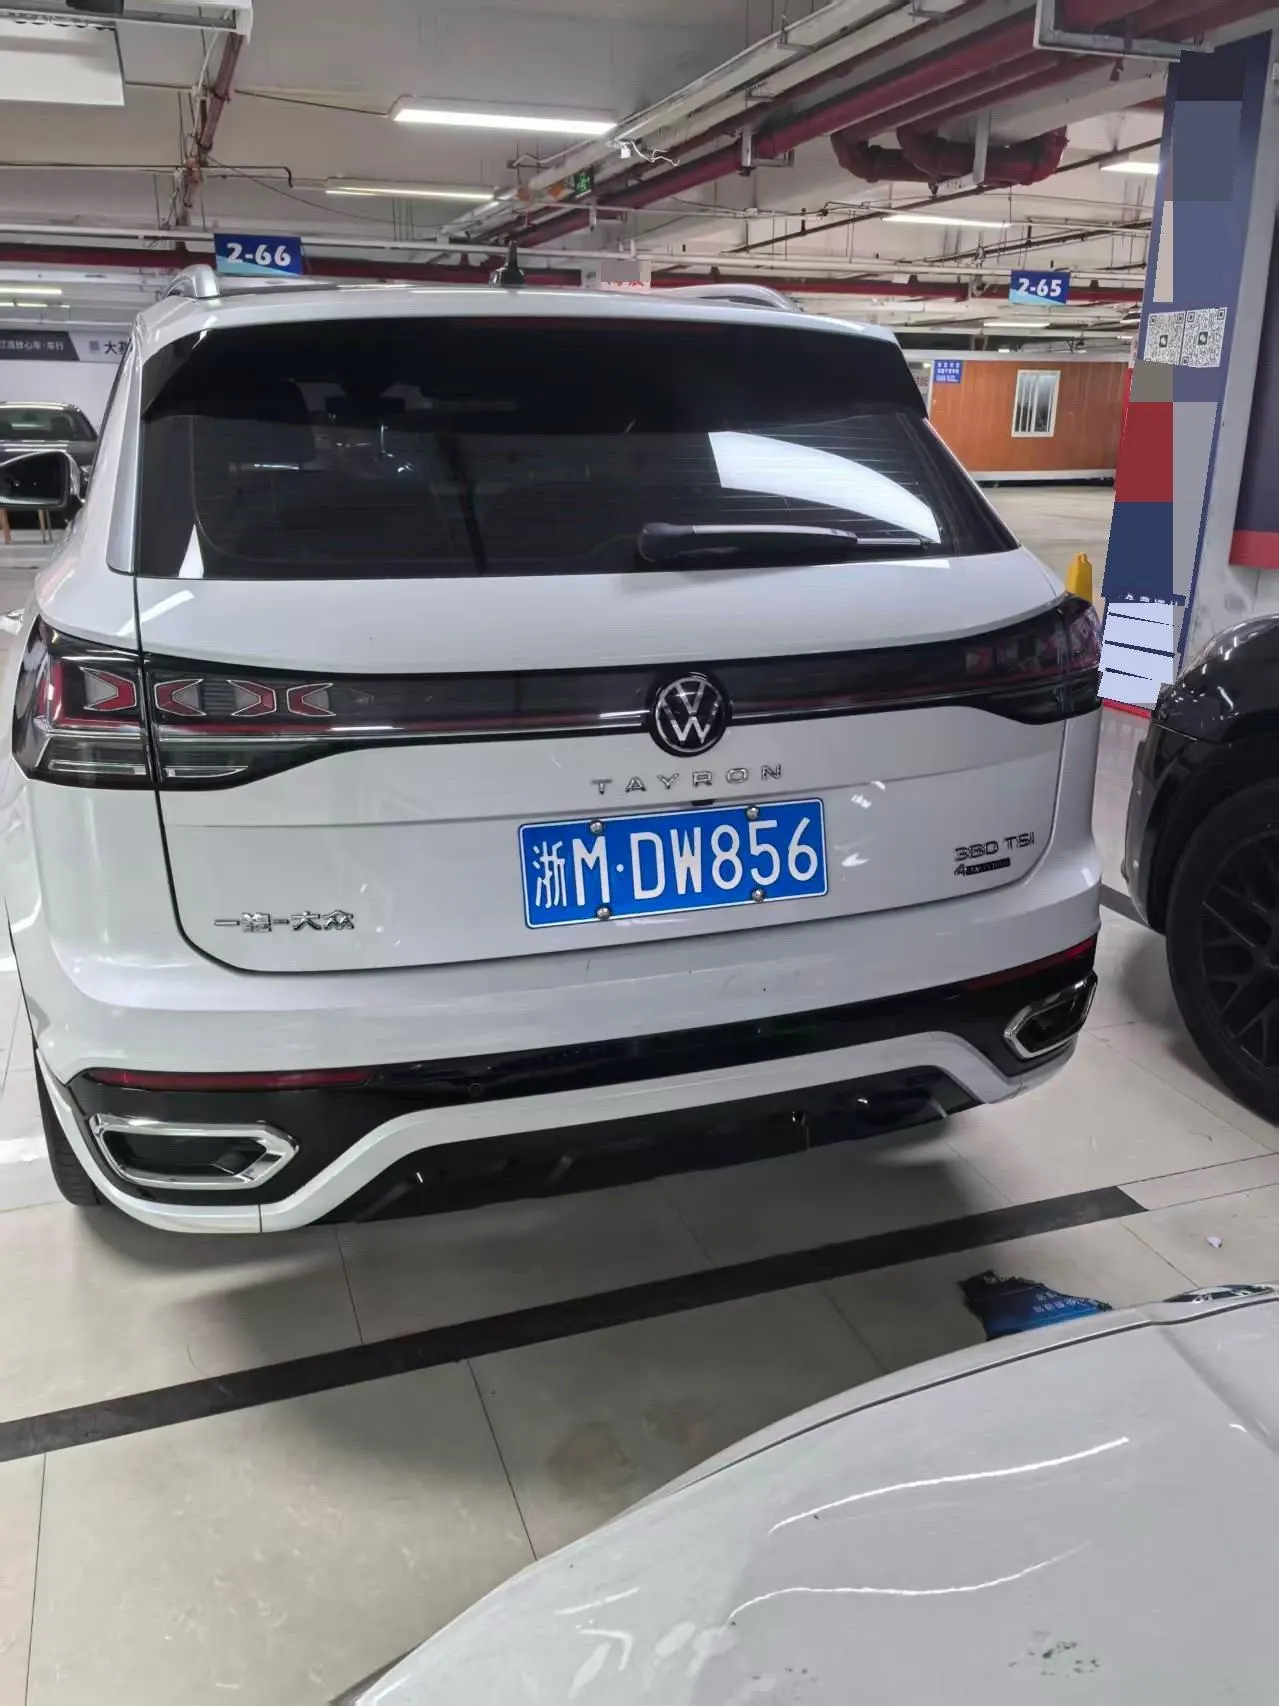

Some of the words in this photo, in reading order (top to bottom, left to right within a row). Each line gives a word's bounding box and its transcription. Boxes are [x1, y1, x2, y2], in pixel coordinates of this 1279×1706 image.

[226, 243, 291, 267] 2-66
[1017, 278, 1062, 297] 2-65
[591, 764, 782, 795] TAYRON
[954, 840, 999, 862] 380
[1004, 832, 1034, 850] TSI
[532, 817, 819, 909] 浙M·DW856
